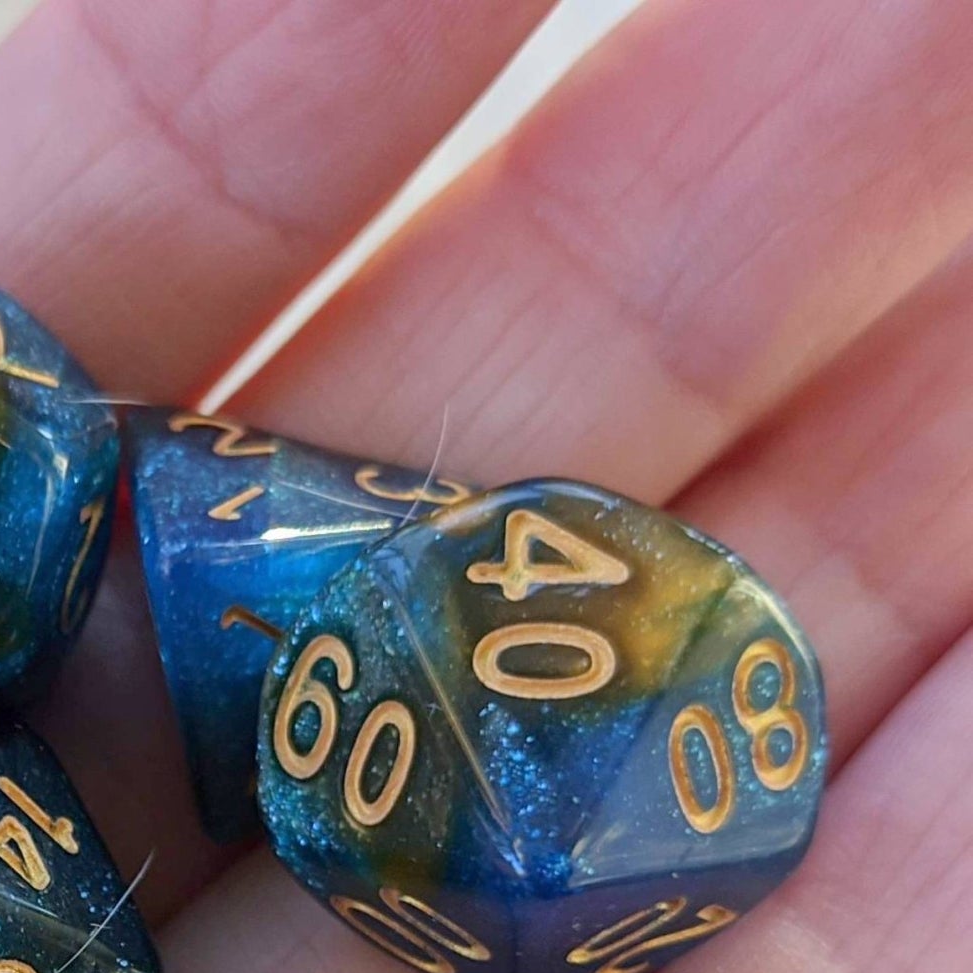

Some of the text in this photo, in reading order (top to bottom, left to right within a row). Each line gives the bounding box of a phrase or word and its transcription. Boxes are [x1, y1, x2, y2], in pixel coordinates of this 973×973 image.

[467, 510, 630, 699] 40
[273, 635, 416, 826] 60
[668, 638, 808, 834] 80
